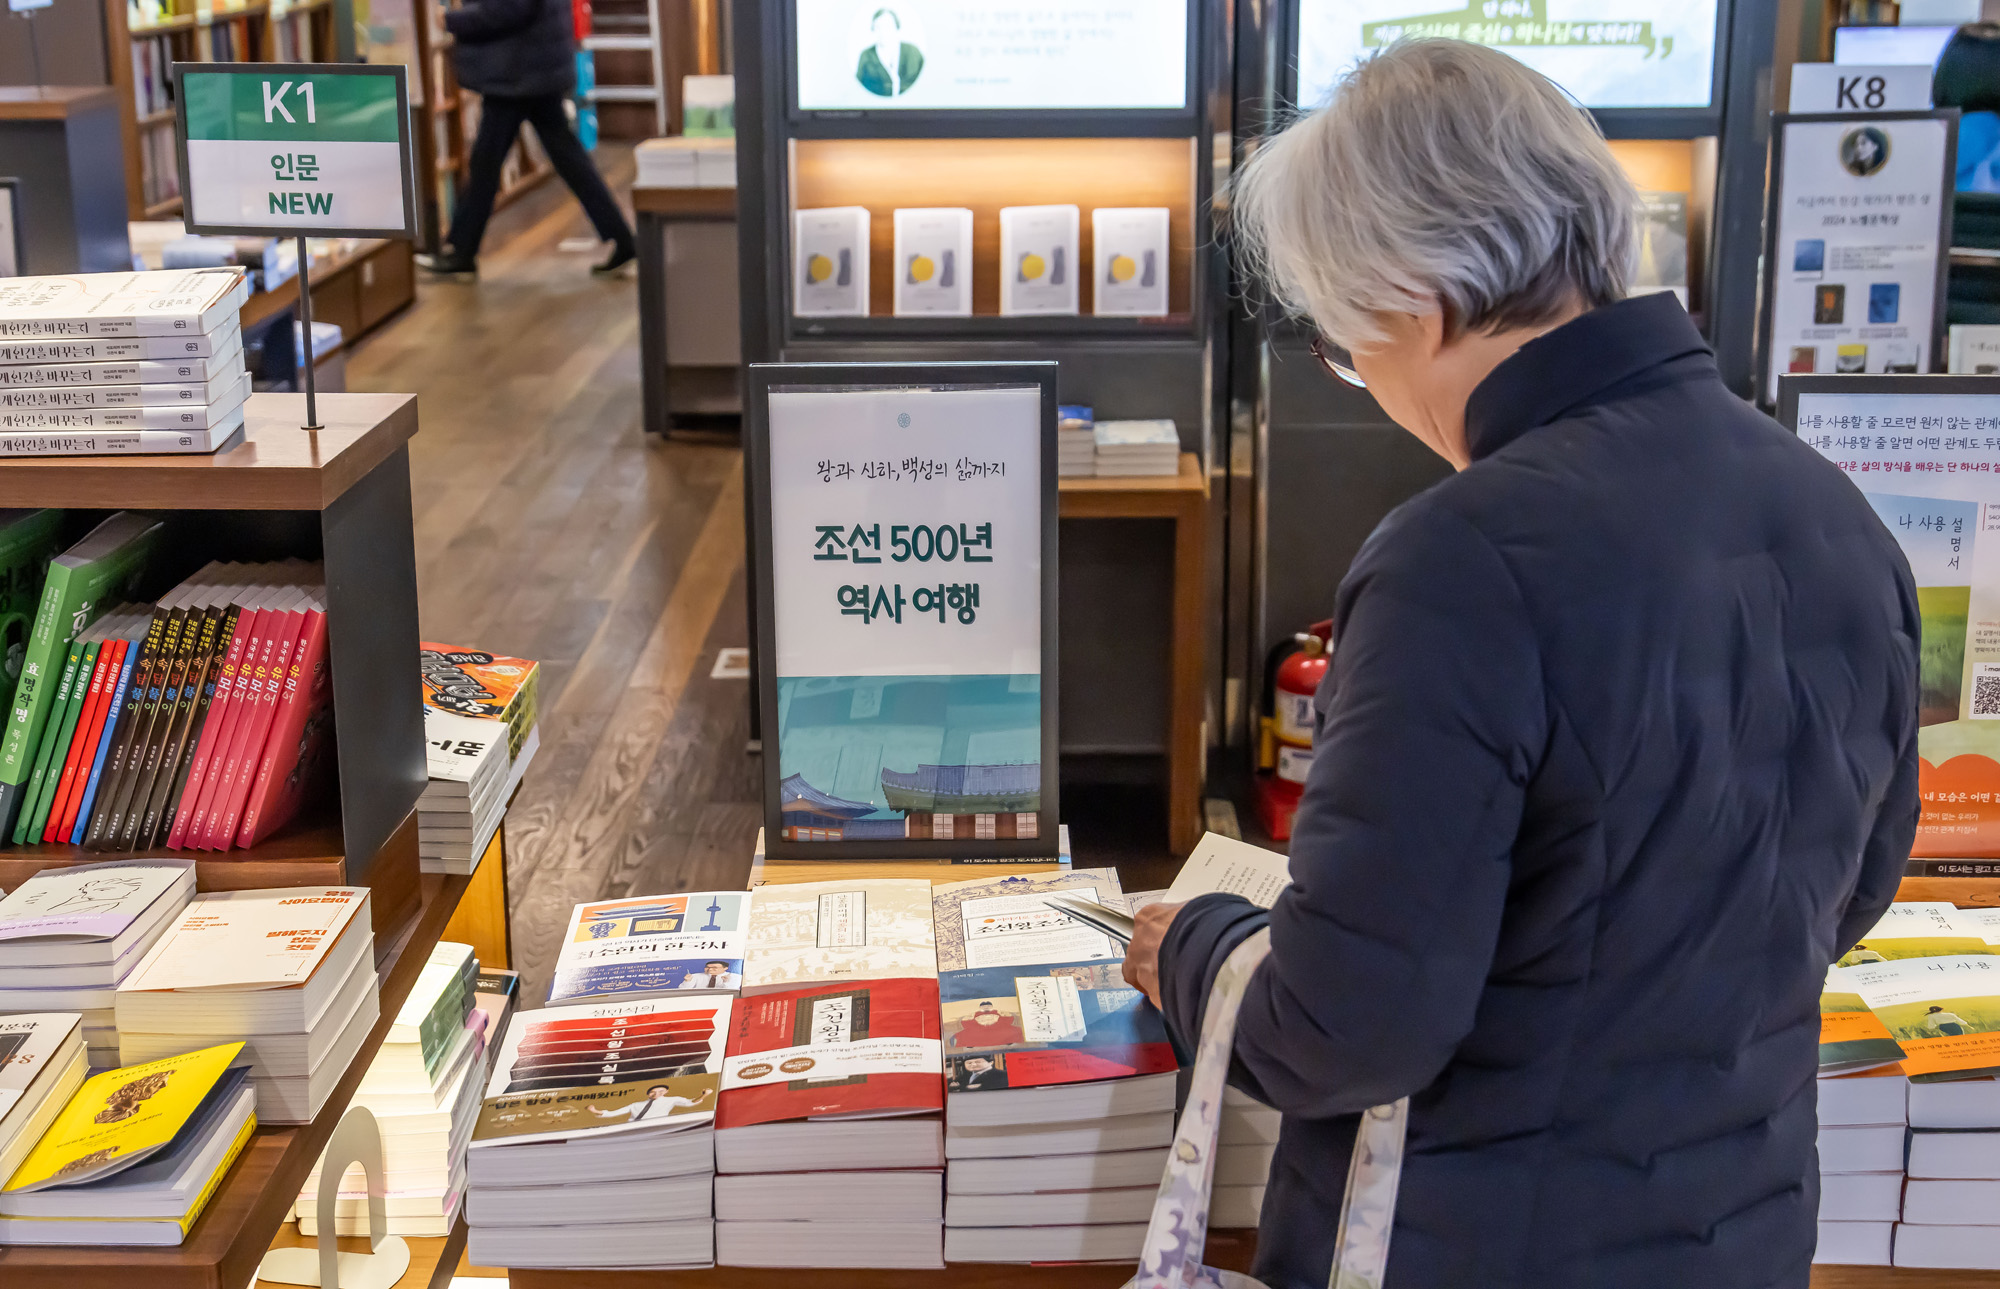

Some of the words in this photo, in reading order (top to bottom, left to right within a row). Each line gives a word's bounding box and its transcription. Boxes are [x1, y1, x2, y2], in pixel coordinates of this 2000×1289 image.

[262, 81, 317, 123] K1
[1836, 77, 1887, 110] K8
[270, 154, 319, 182] 인문
[268, 192, 333, 216] NEW
[1800, 415, 1824, 429] 나를
[1826, 415, 1862, 429] 사용할
[1865, 416, 1879, 429] 줄
[1881, 416, 1917, 430] 모르면
[1919, 416, 1943, 430] 원치
[1946, 416, 1972, 430] 않는
[1974, 416, 2000, 430] 관계
[1808, 435, 1833, 449] 나를
[1835, 436, 1872, 450] 사용할
[1875, 436, 1888, 450] 줄
[1890, 436, 1914, 450] 알면
[1916, 437, 1941, 450] 어떤
[1943, 437, 1981, 450] 관계도
[816, 459, 855, 483] 왕과
[954, 456, 1006, 481] 삶까지
[1835, 461, 1858, 472] 다운
[1861, 461, 1881, 472] 삶의
[1883, 461, 1912, 473] 방식을
[1915, 461, 1945, 473] 배우는
[1947, 461, 1958, 473] 단
[1960, 462, 1990, 473] 하나의
[1899, 514, 1913, 530] 나
[1918, 515, 1946, 532] 사용
[813, 522, 883, 563] 조선
[890, 521, 994, 563] 500년
[1947, 517, 1963, 570] 설명서
[836, 583, 907, 625] 역사
[912, 582, 981, 625] 여행
[1924, 791, 1935, 802] 내
[1937, 792, 1968, 803] 모습은
[1970, 792, 1991, 803] 어떤
[1938, 865, 1947, 873] 이
[1948, 865, 1974, 874] 도서는
[1974, 865, 1992, 874] 광고
[278, 897, 351, 906] 식이요법이
[265, 929, 328, 938] 말해주지
[974, 916, 1077, 934] 조선왕조실
[1927, 963, 1946, 973] 나
[1955, 961, 1993, 970] 사용
